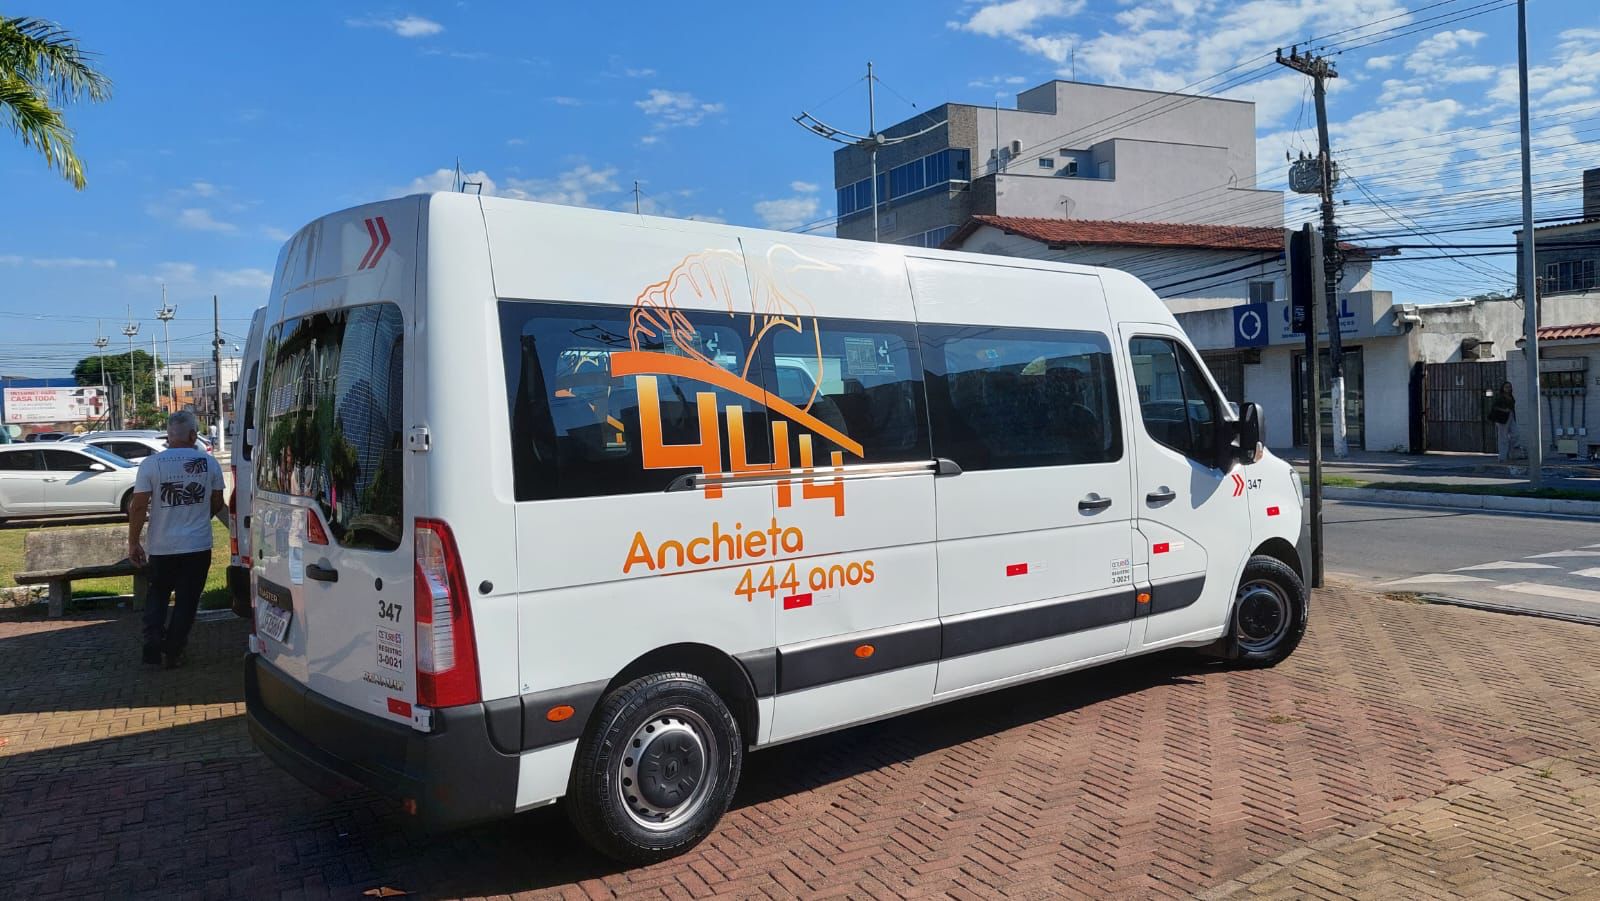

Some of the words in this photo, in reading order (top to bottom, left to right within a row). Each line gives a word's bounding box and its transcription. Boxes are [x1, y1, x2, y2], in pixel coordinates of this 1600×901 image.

[1247, 478, 1262, 490] 347
[622, 517, 804, 574] Anchieta
[734, 562, 800, 602] 444
[808, 560, 875, 592] anos
[378, 600, 402, 622] 347
[378, 644, 402, 657] REGISTRO
[378, 653, 402, 669] 3-0021
